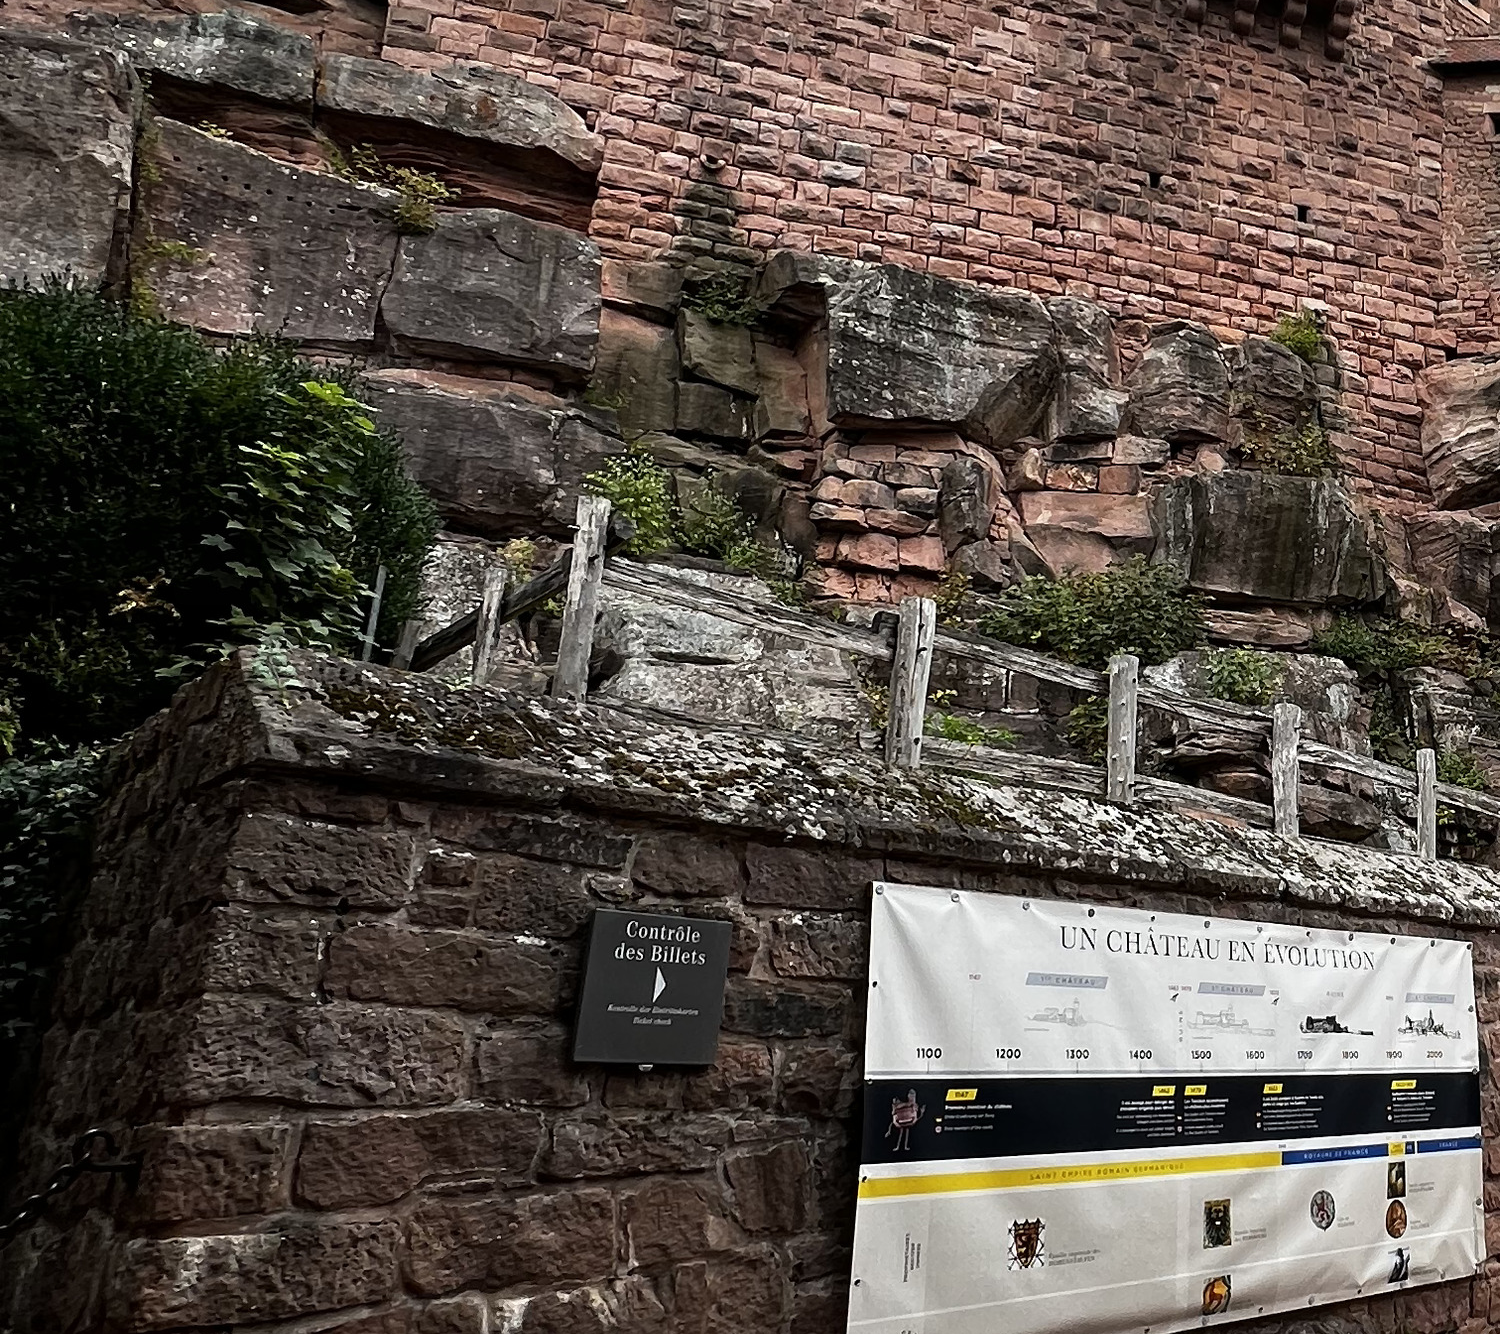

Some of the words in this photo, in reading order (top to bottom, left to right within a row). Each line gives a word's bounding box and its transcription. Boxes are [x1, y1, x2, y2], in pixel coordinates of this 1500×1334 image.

[626, 920, 701, 943] Contrôle
[1060, 925, 1097, 951] UN
[1106, 926, 1221, 961] CHÂTEAU
[1228, 940, 1256, 963] EN
[1264, 938, 1376, 971] ÉVOLUTION
[614, 942, 645, 961] des
[651, 945, 707, 966] Billets
[916, 1048, 942, 1060] 1100
[996, 1048, 1021, 1060] 1200
[1065, 1048, 1090, 1060] 1300
[1129, 1050, 1153, 1060] 1400
[1191, 1050, 1212, 1060] 1500
[1246, 1050, 1265, 1060] 1600
[1297, 1050, 1313, 1060] 1700
[1342, 1050, 1359, 1060] 1800
[1385, 1050, 1402, 1060] 1900
[1426, 1050, 1443, 1059] 2000
[1030, 1171, 1057, 1180] SAINT
[1061, 1169, 1092, 1178] EMPIRE
